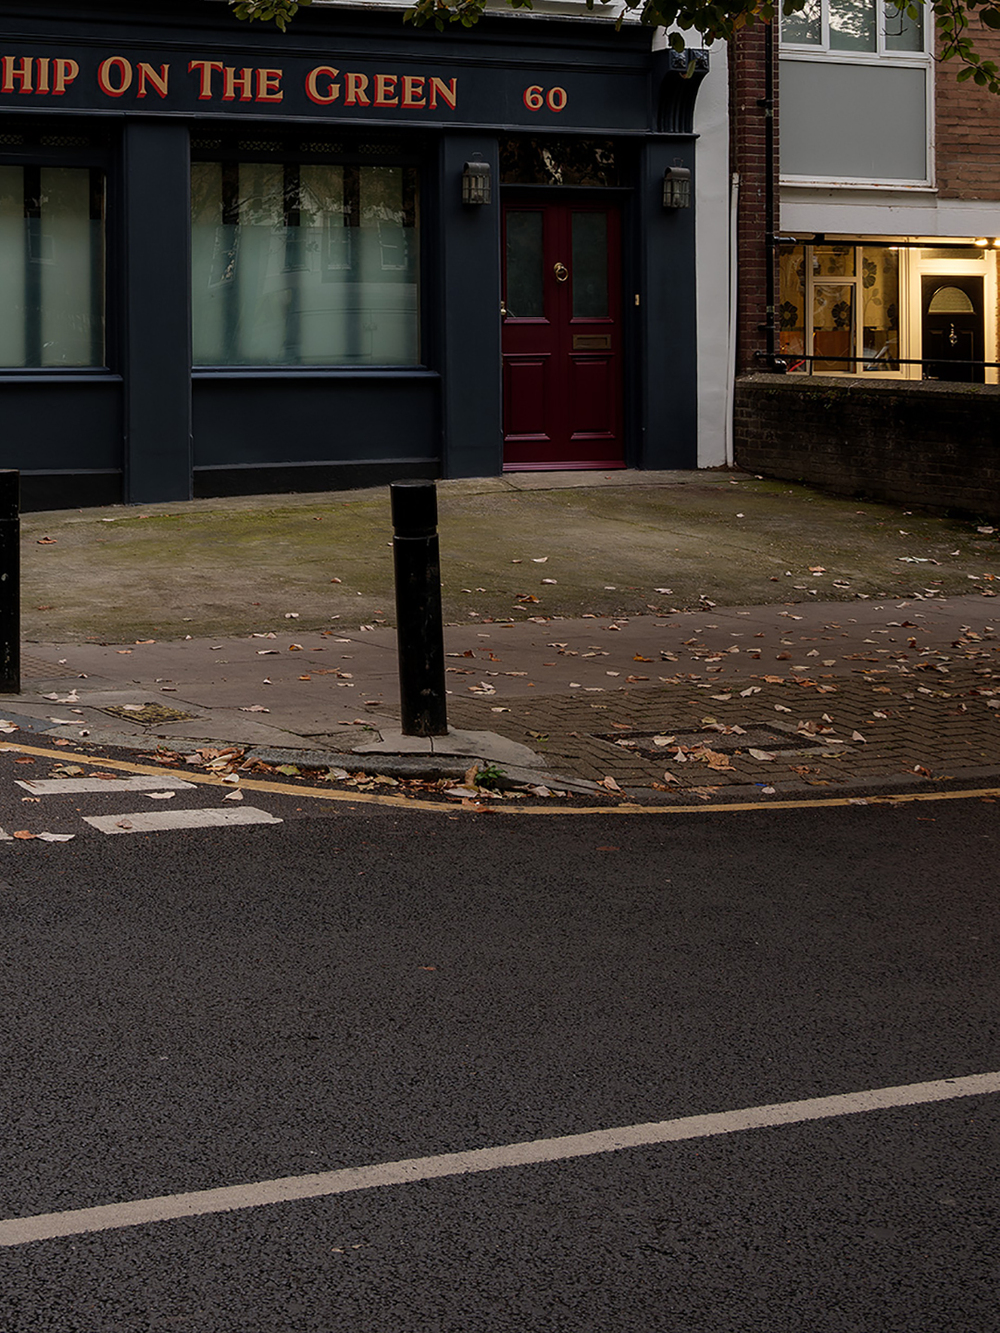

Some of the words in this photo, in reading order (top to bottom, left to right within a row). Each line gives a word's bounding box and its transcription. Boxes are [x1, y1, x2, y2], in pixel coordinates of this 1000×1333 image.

[97, 56, 170, 99] ON
[187, 60, 284, 103] THE
[304, 65, 458, 111] GREEN
[522, 85, 568, 113] 60
